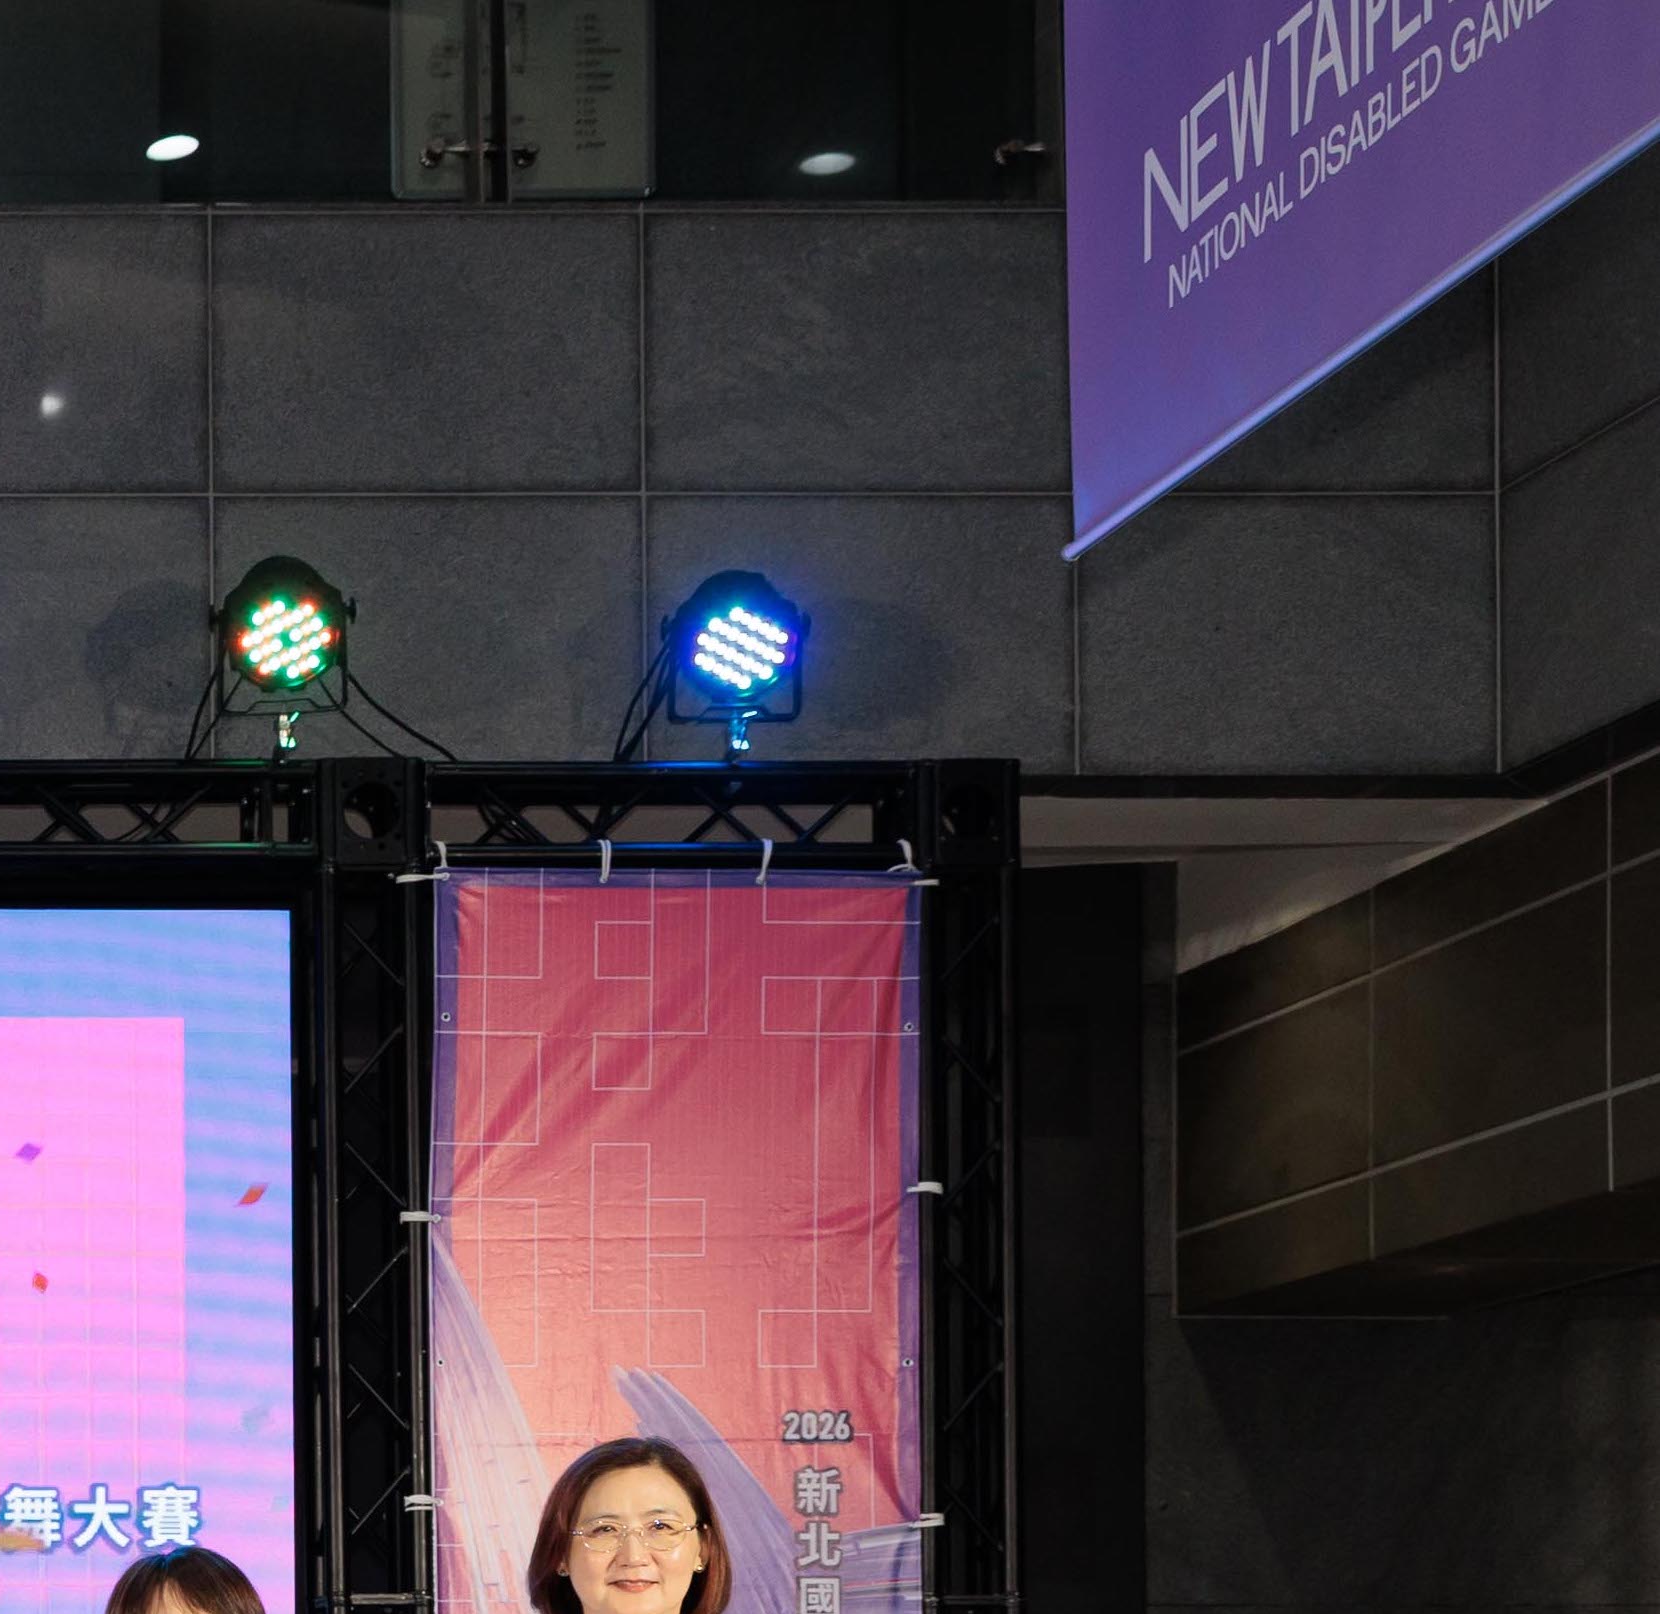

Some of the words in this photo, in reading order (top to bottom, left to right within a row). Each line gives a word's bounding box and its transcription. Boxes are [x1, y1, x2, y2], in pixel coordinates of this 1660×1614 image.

[1143, 40, 1271, 262] NEW
[1169, 171, 1292, 308] NATIONAL
[1300, 45, 1442, 198] DISABLED
[783, 1412, 852, 1442] 2026
